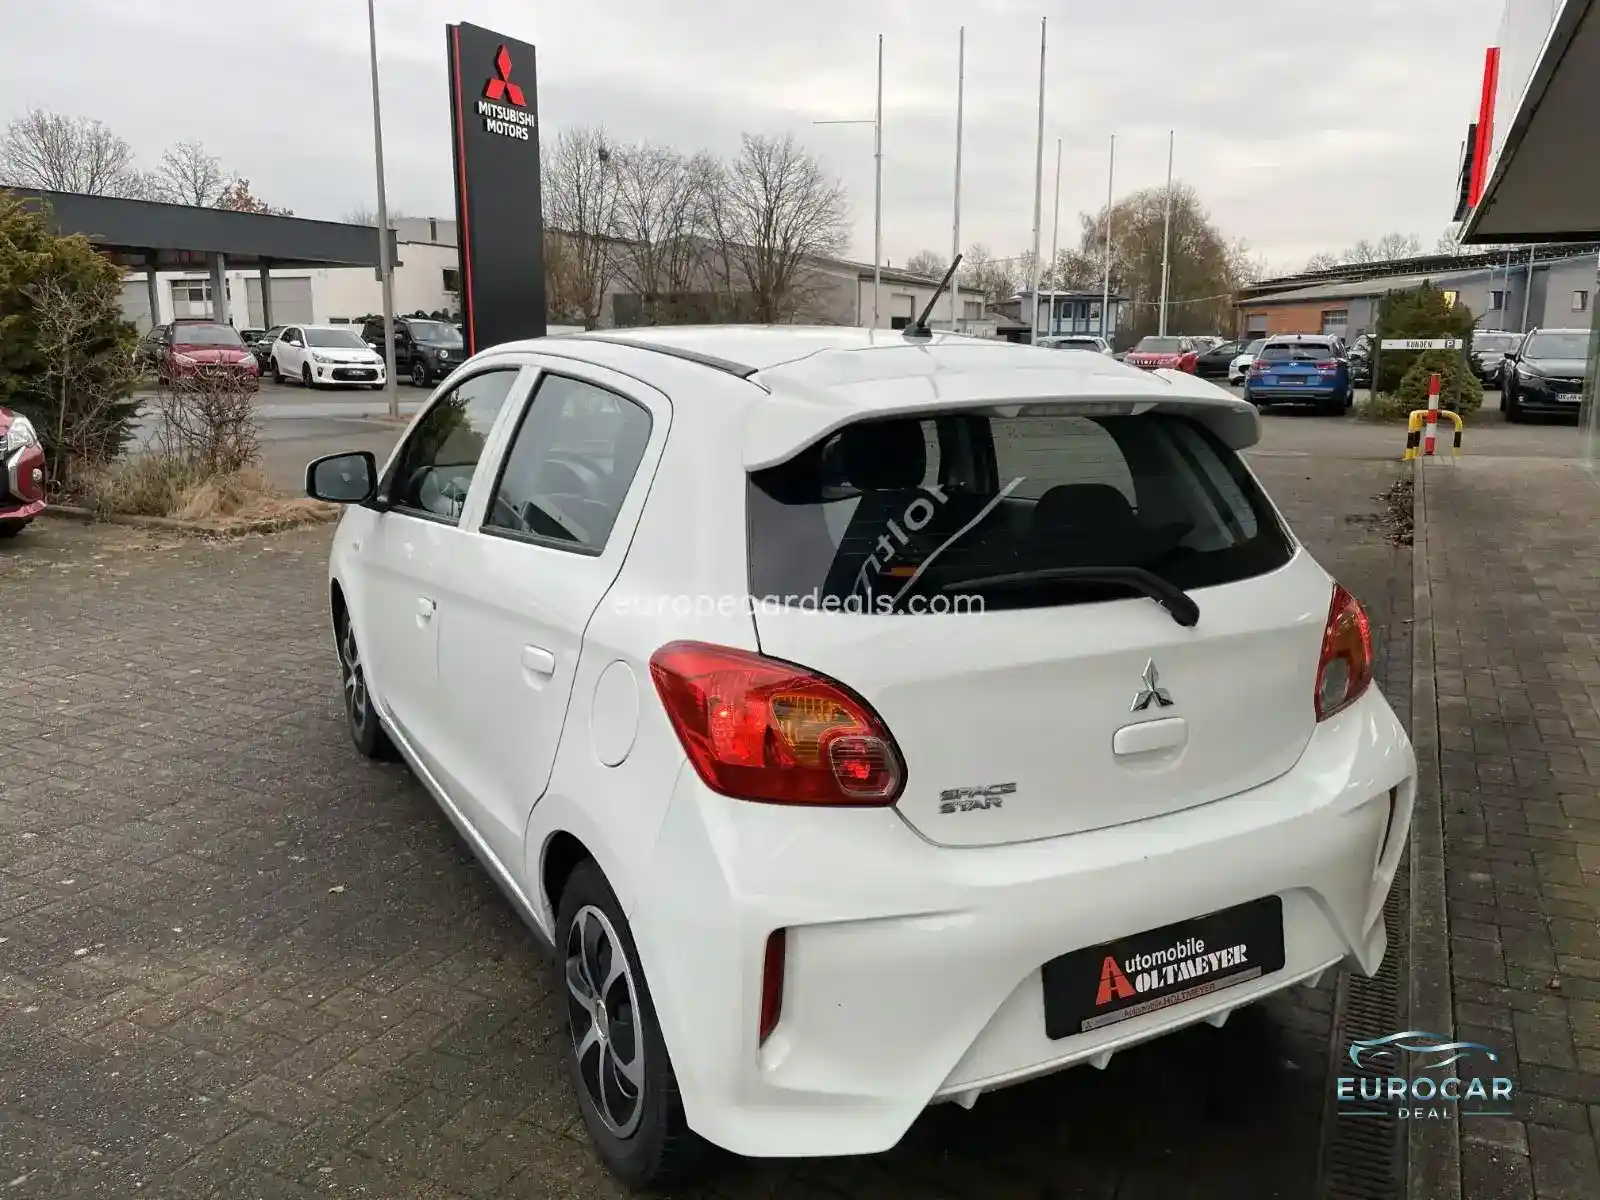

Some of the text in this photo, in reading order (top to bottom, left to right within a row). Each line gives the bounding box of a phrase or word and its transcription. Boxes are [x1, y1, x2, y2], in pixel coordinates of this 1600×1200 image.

[478, 100, 535, 127] MITSUBISHI
[486, 118, 529, 140] MOTORS
[940, 782, 1017, 801] SPACE
[938, 797, 1003, 813] STAR
